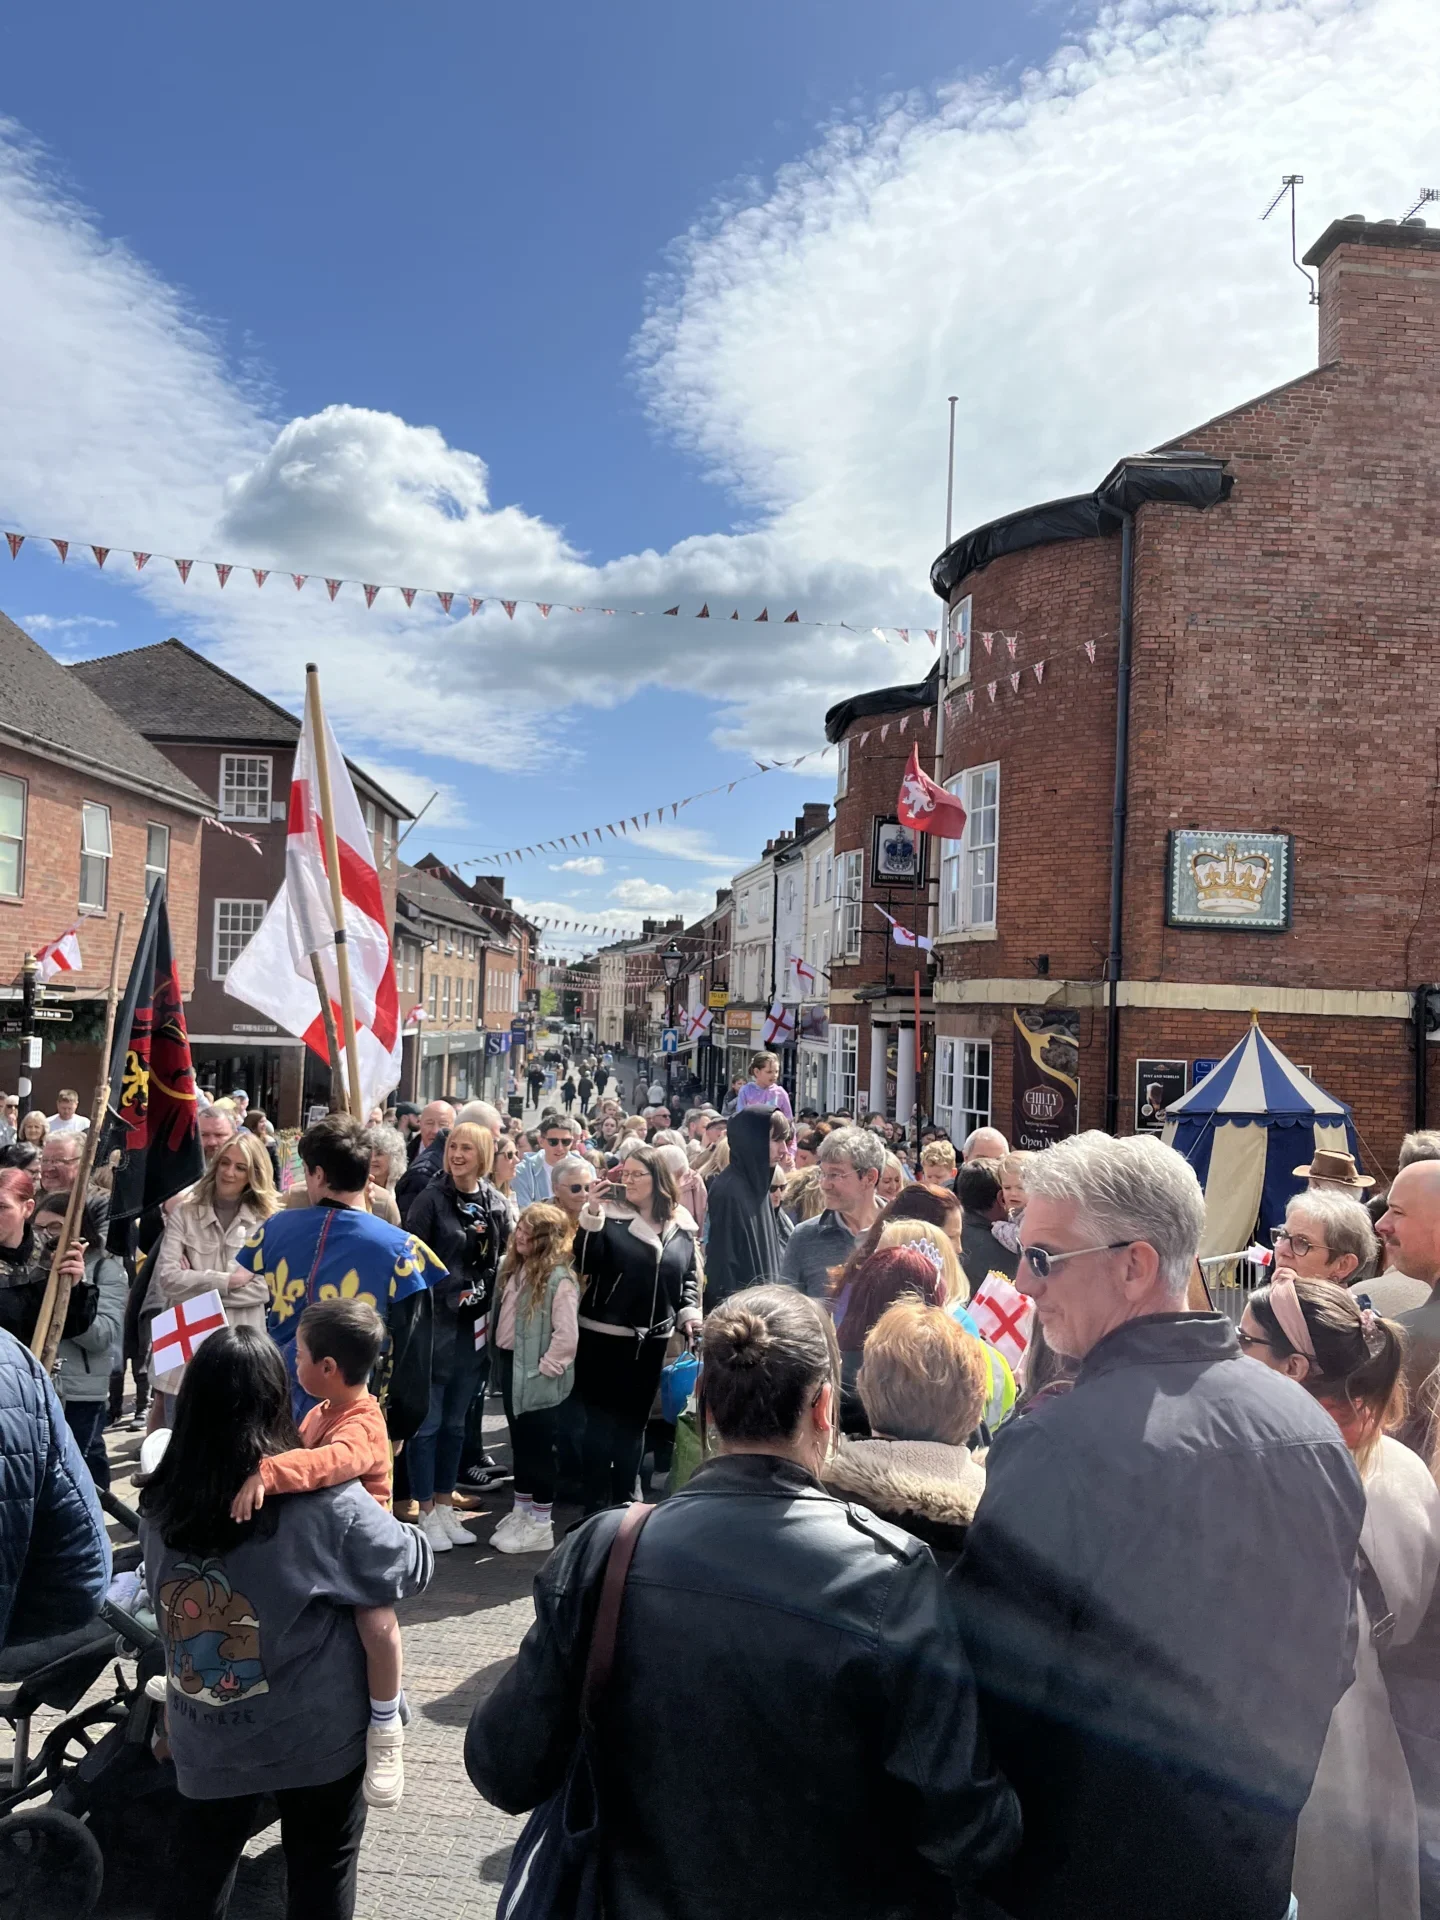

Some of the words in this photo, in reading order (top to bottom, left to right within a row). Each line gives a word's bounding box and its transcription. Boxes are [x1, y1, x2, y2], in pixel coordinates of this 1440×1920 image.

[1025, 1091, 1058, 1106] CHILLY
[1030, 1103, 1053, 1117] DUM
[1020, 1134, 1043, 1149] Open
[173, 1695, 197, 1724] SUN
